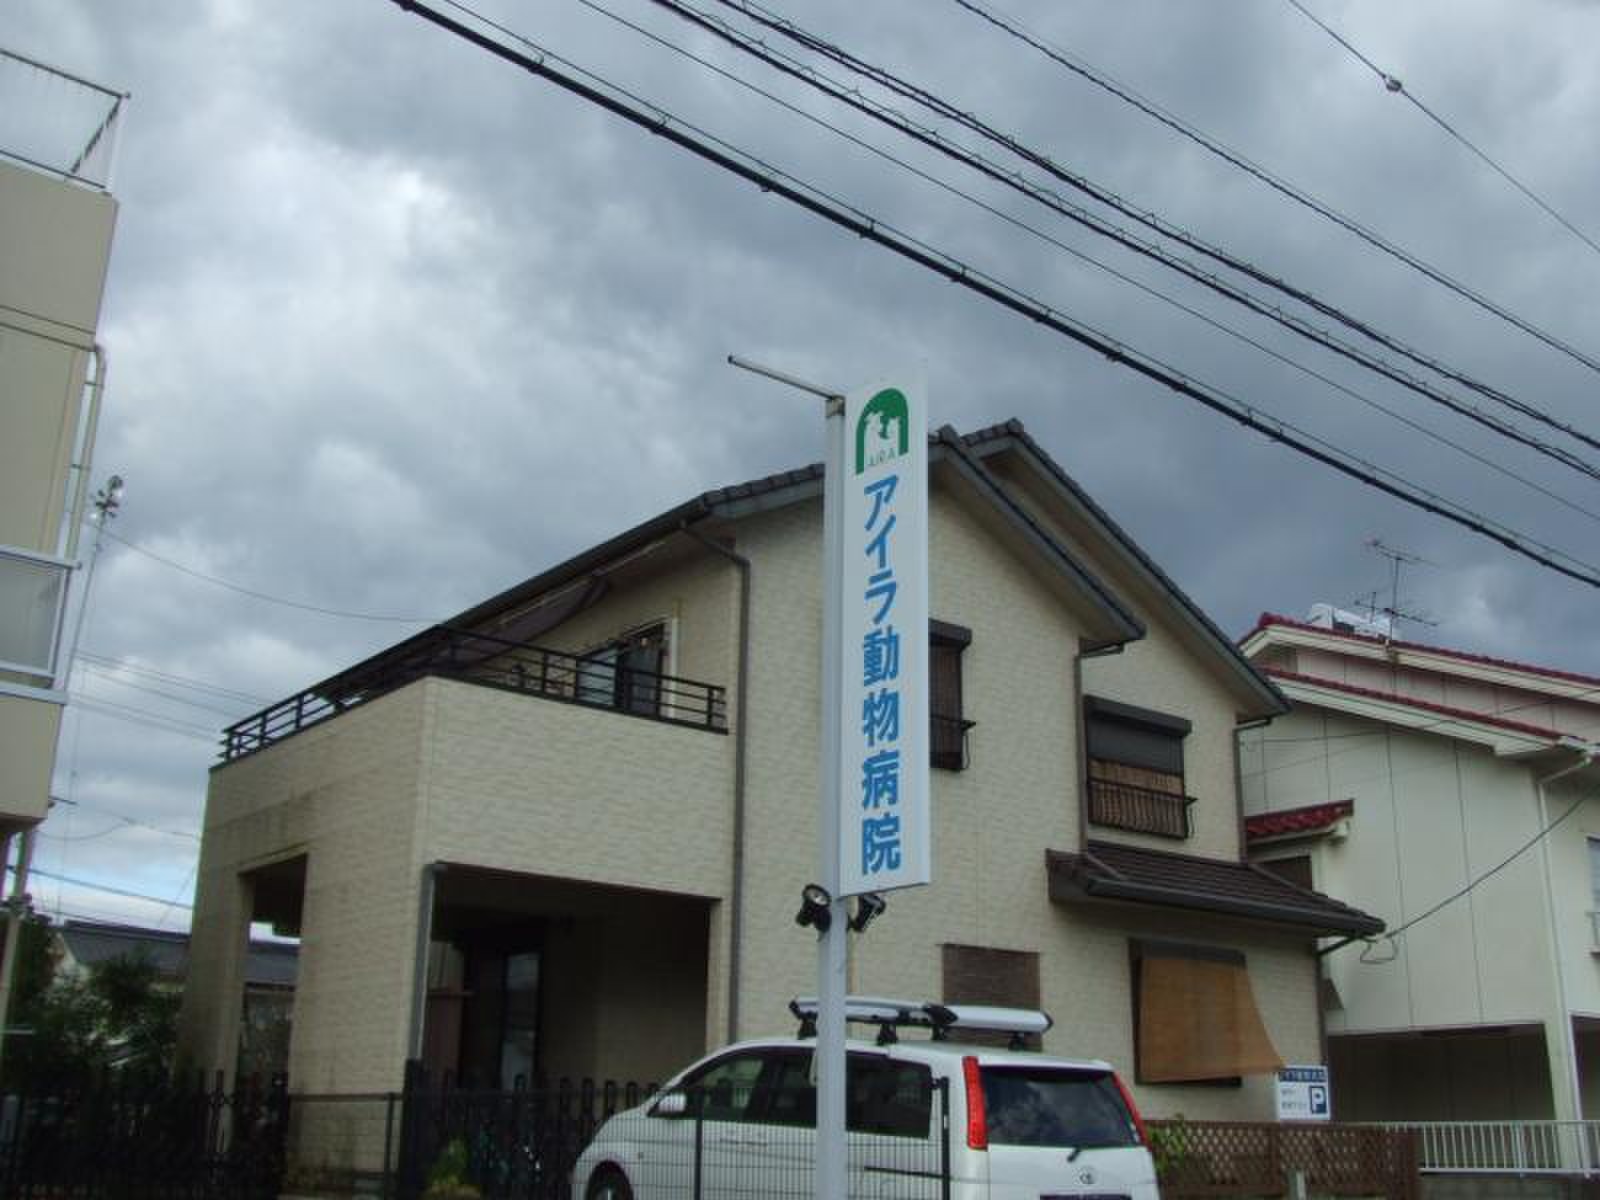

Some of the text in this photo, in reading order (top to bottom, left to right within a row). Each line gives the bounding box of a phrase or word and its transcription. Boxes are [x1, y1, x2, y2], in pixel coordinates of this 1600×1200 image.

[861, 475, 902, 875] アイラ動物病院
[1311, 1087, 1325, 1112] P
